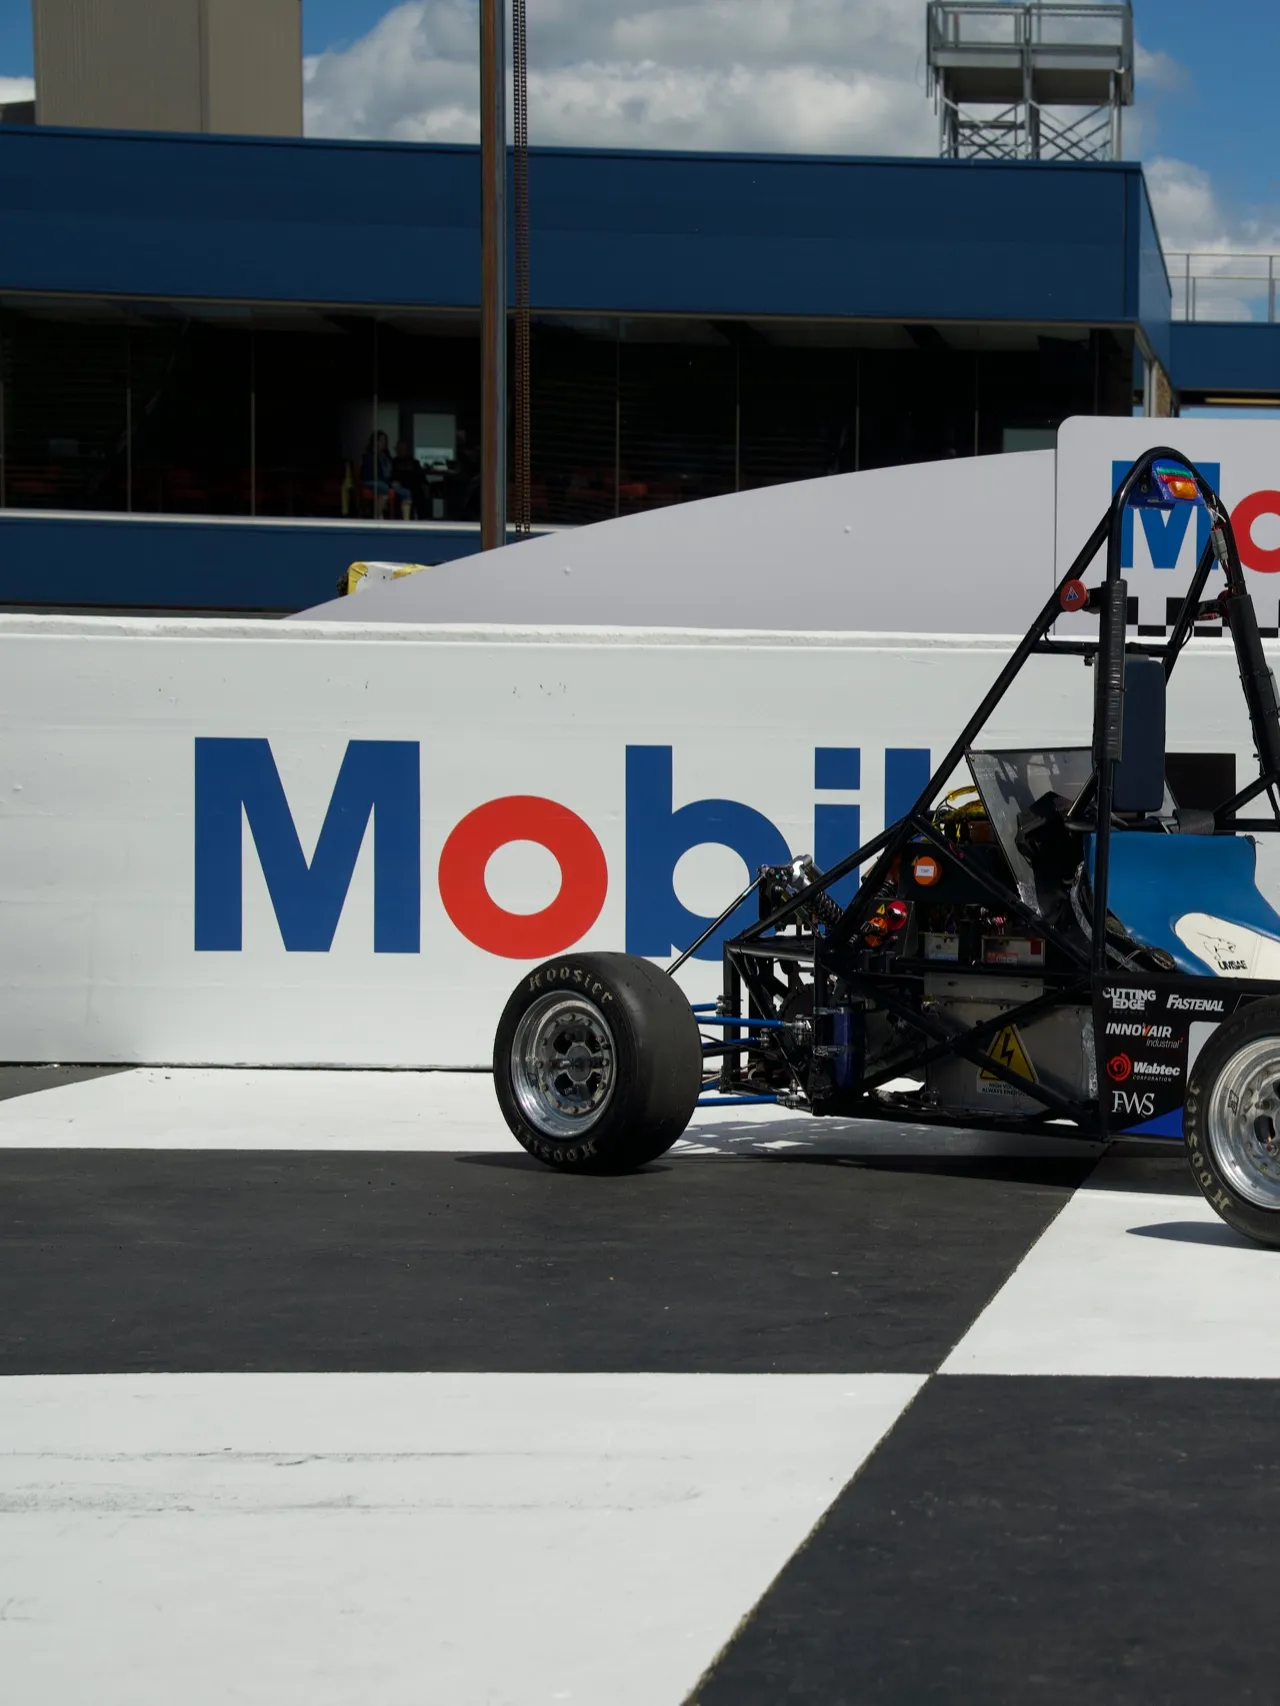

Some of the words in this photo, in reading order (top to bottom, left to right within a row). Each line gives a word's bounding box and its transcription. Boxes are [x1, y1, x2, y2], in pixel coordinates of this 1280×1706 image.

[194, 737, 931, 961] Mobi
[1102, 987, 1157, 1002] CUTTING
[1112, 998, 1145, 1011] EDGE
[1166, 994, 1224, 1012] FASTENAL
[1146, 1038, 1181, 1049] Industrial
[1133, 1061, 1181, 1076] Wabtec
